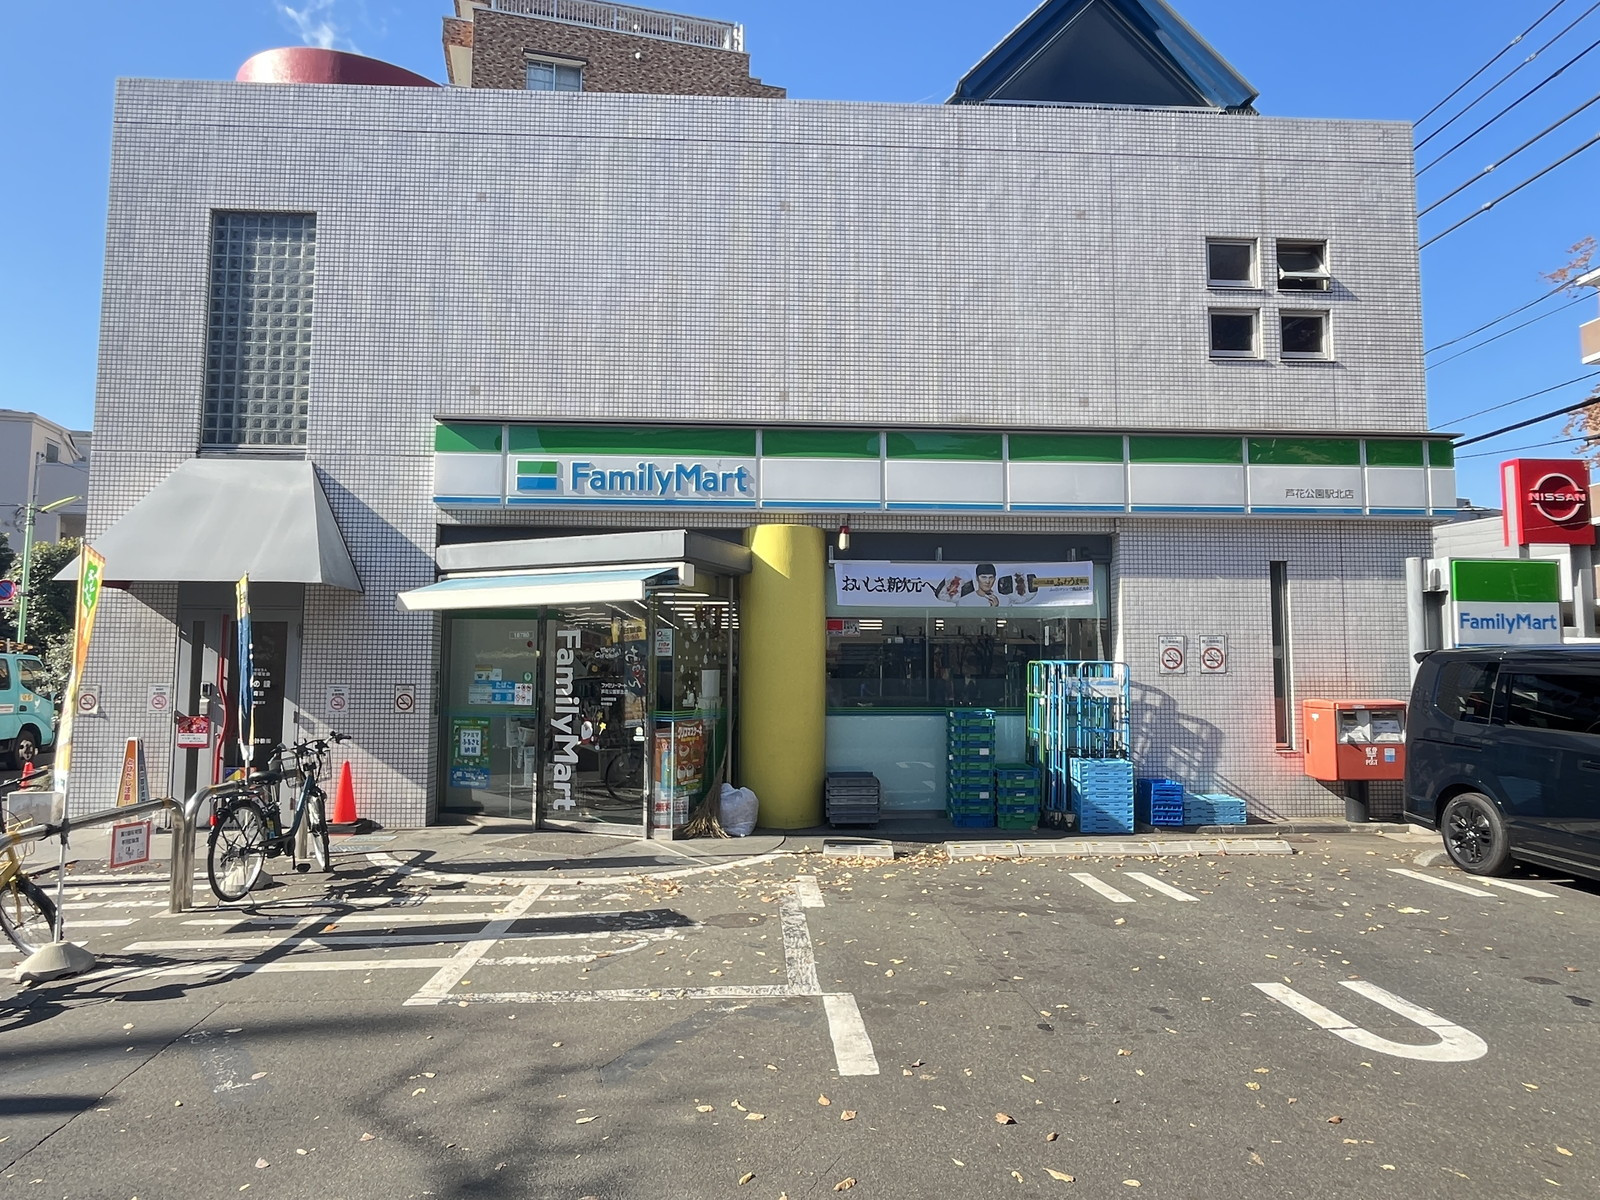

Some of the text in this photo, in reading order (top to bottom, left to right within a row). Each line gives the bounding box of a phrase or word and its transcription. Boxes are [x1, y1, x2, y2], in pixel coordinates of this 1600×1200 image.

[570, 461, 748, 496] FamilyMart
[1285, 488, 1354, 499] 芦花公園駅北店
[1527, 492, 1587, 503] NISSAN
[1459, 612, 1558, 635] FamilyMart
[550, 629, 582, 811] FamilyMart
